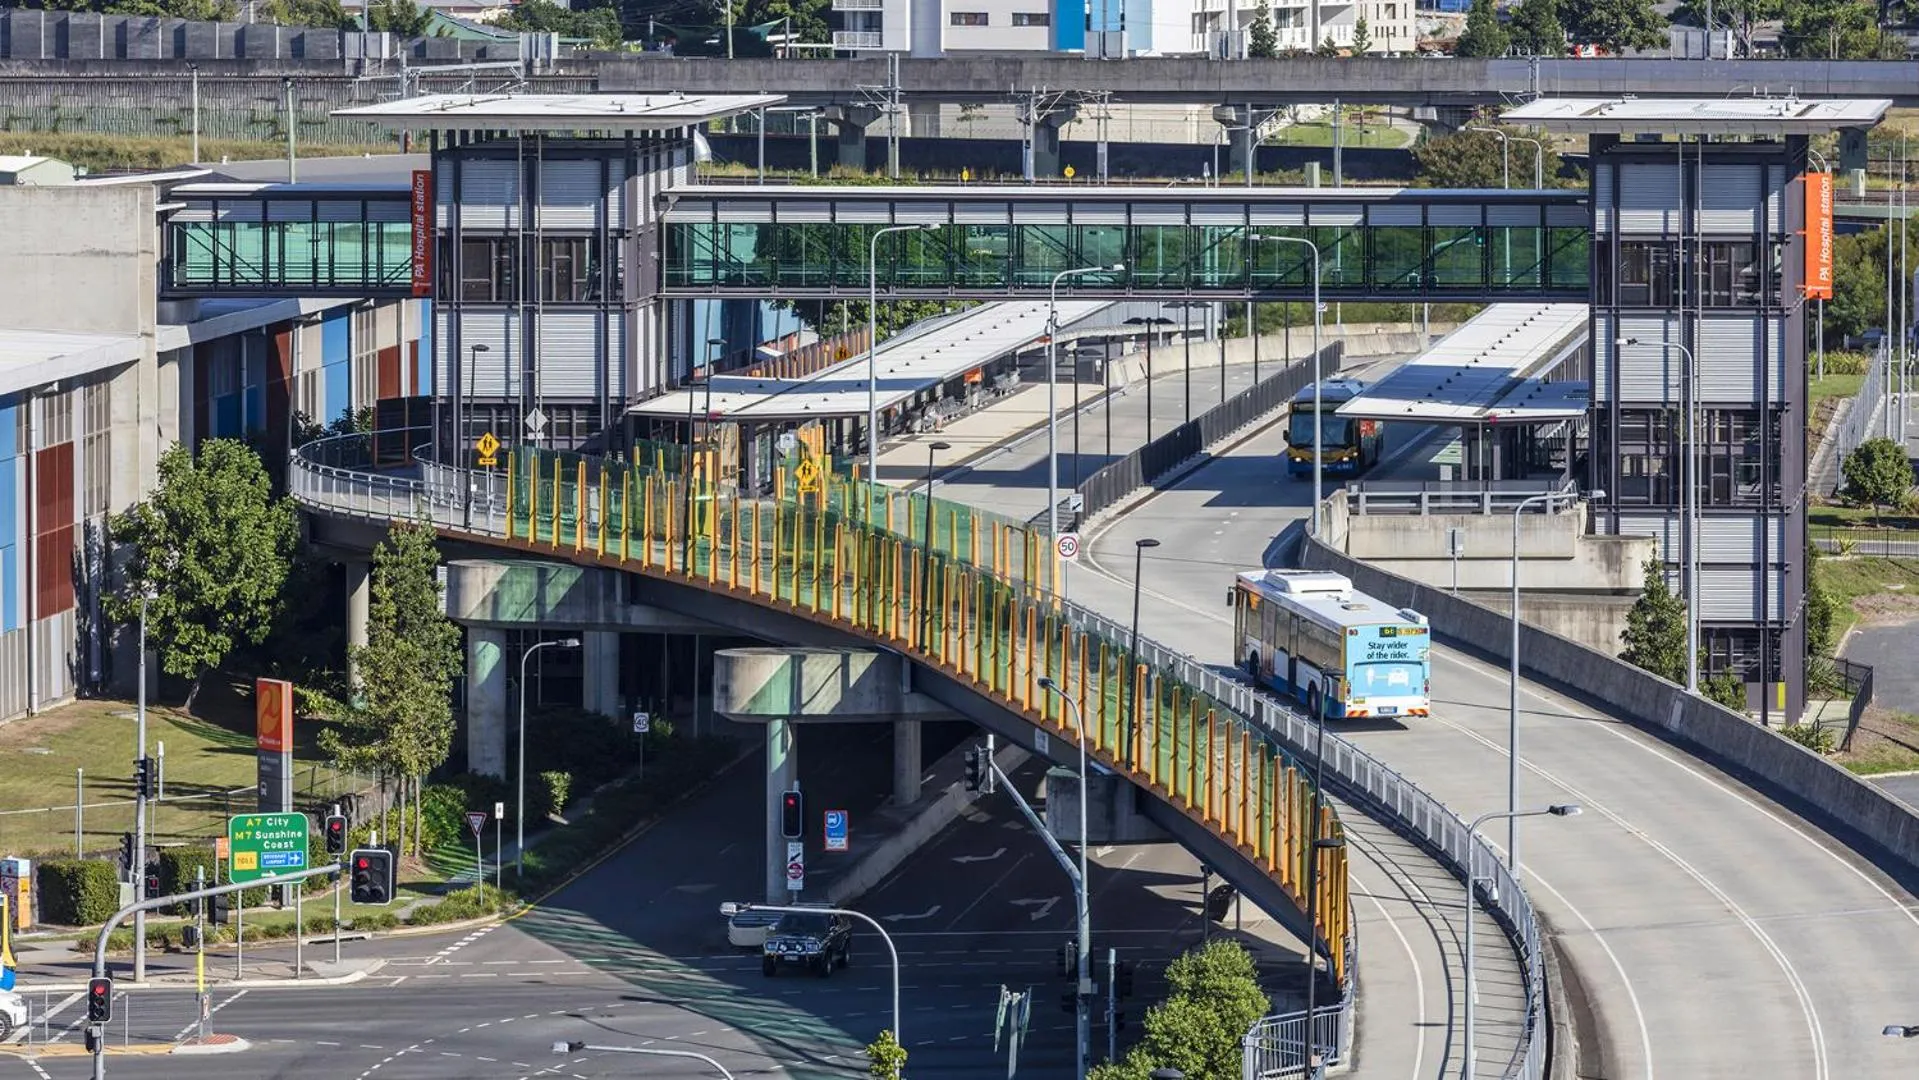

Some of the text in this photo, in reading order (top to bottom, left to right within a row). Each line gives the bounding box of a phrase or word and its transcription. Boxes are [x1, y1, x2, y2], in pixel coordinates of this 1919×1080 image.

[414, 174, 425, 212] station
[1820, 176, 1832, 281] PA Hospital station
[415, 214, 427, 260] Hospital
[415, 263, 425, 278] PA
[1061, 542, 1074, 551] 50
[1368, 641, 1409, 651] Stay wider
[1366, 651, 1410, 660] of the rider.
[636, 718, 647, 726] 40
[246, 817, 289, 828] A7 City
[235, 830, 303, 840] M7 Sunshine
[263, 840, 295, 850] Coast
